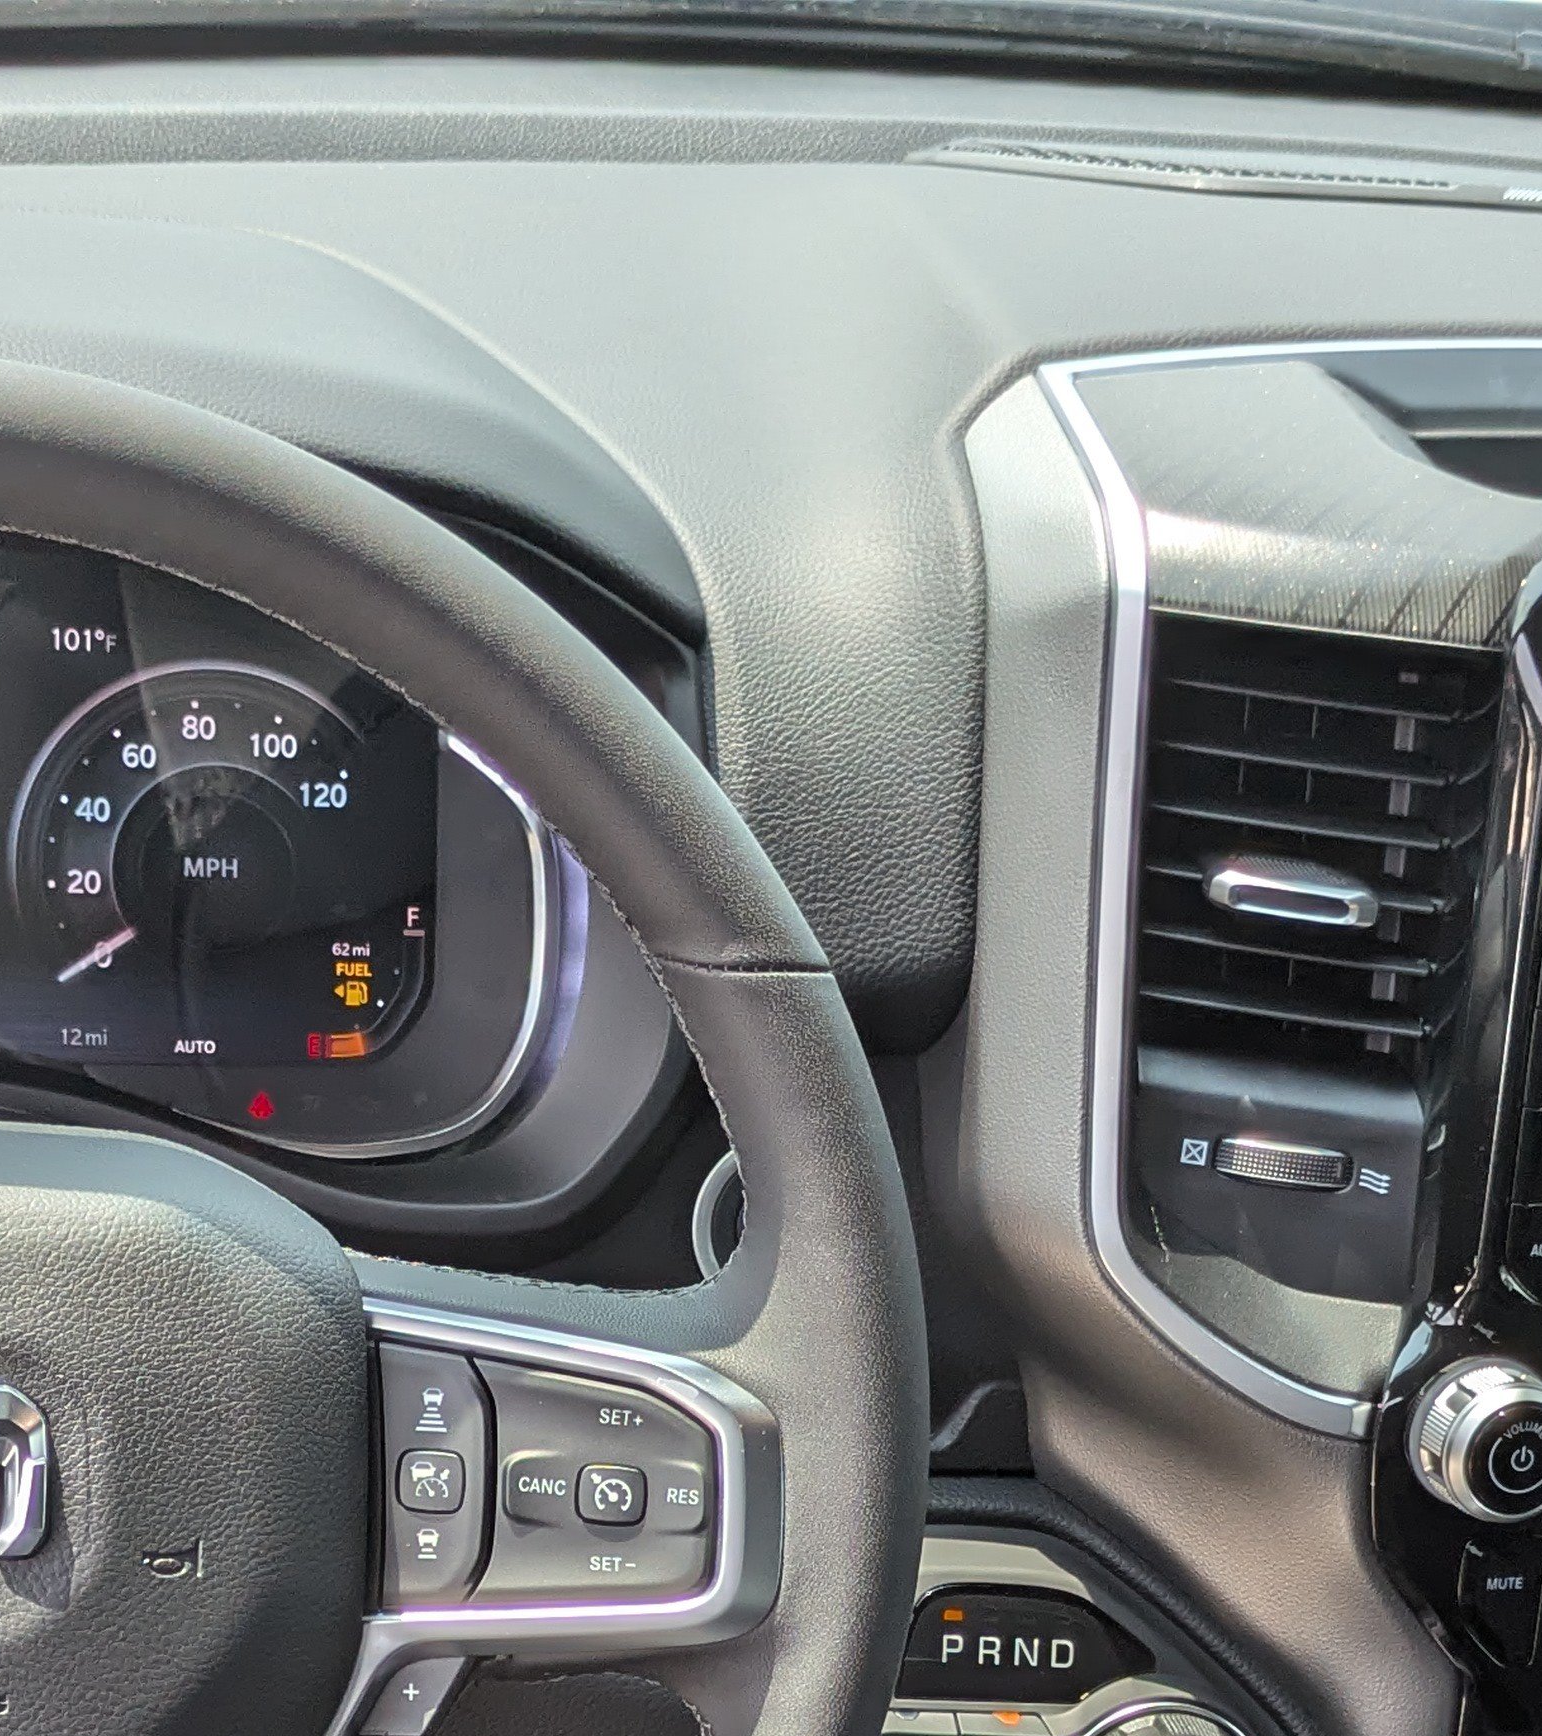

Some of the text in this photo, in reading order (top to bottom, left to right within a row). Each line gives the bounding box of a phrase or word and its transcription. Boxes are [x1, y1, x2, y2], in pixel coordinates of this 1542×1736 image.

[51, 627, 117, 653] 101°F
[181, 715, 216, 741] 80
[122, 744, 157, 769] 60
[250, 734, 297, 759] 100
[300, 783, 347, 809] 120
[75, 797, 111, 823] 40
[183, 858, 239, 879] MPH
[67, 870, 102, 895] 20
[406, 907, 420, 927] F
[335, 963, 372, 978] FUEL
[174, 1040, 217, 1055] AUTO
[518, 1476, 567, 1497] CANC
[666, 1487, 700, 1506] RES
[1486, 1577, 1523, 1591] MUTE
